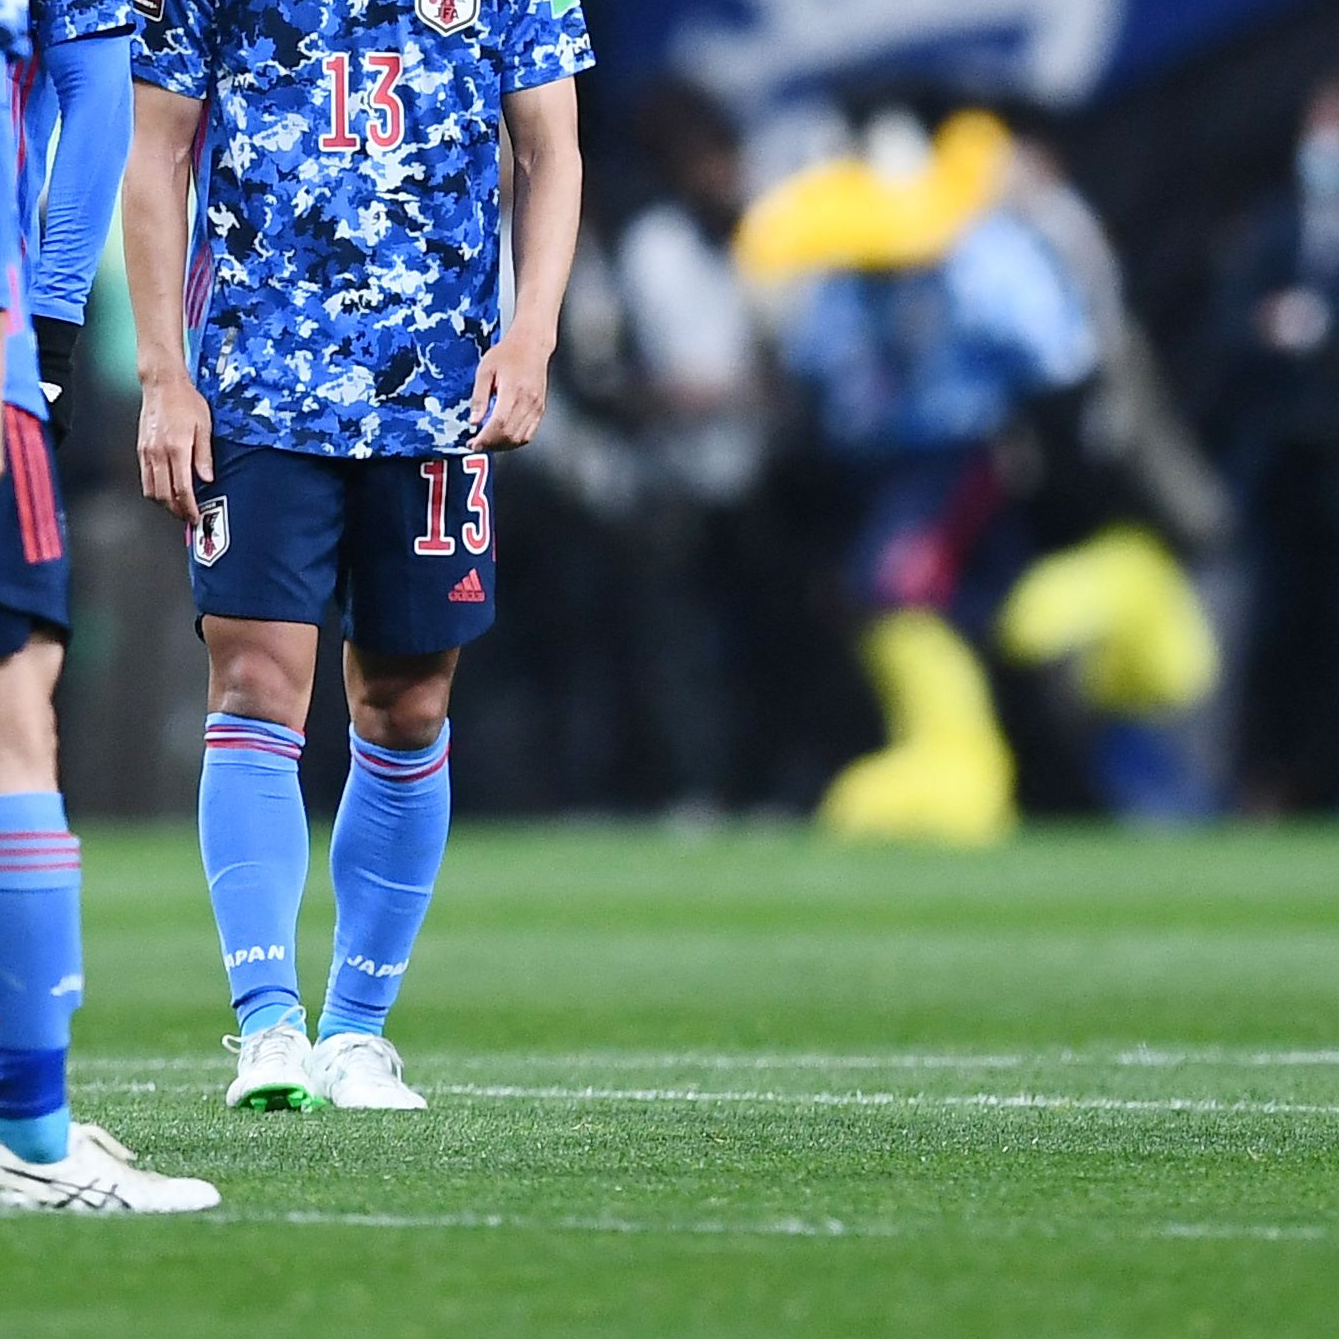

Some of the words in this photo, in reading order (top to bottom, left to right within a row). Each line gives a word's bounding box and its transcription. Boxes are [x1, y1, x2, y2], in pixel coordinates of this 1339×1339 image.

[433, 6, 460, 20] JFA
[318, 51, 405, 152] 13
[414, 453, 490, 556] 13
[224, 944, 285, 971] APAN
[346, 955, 409, 978] JAPA
